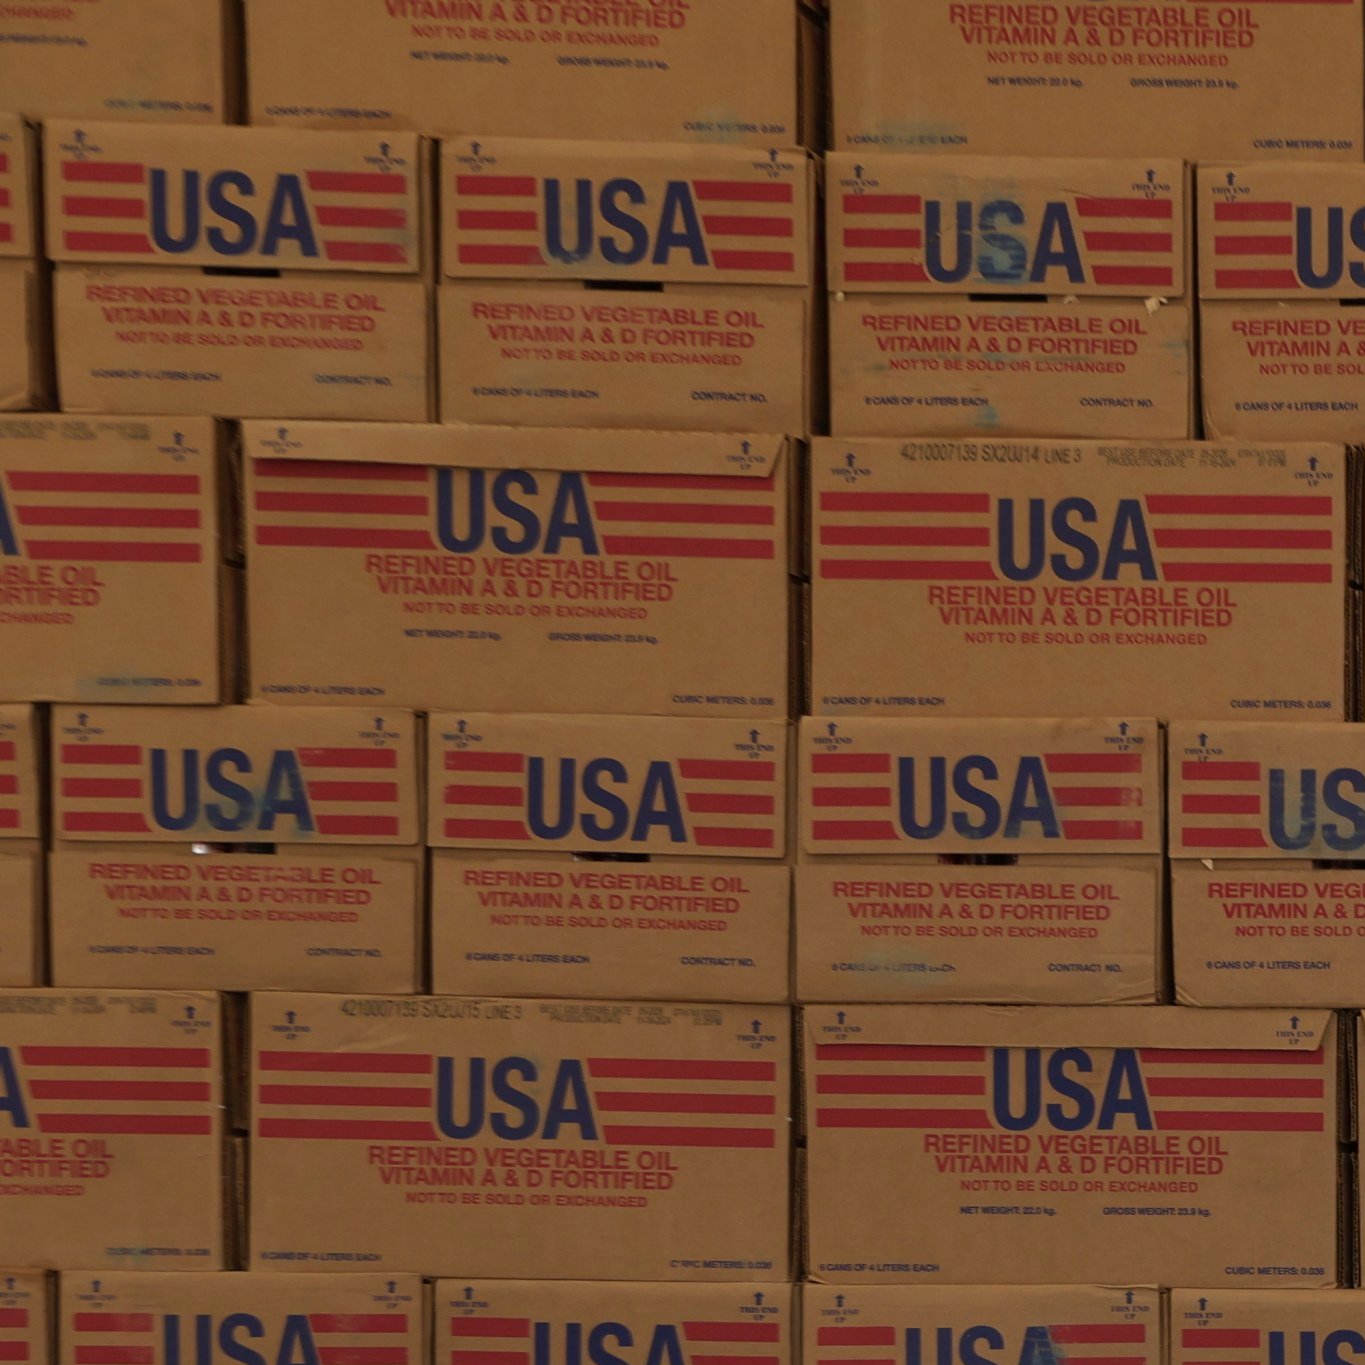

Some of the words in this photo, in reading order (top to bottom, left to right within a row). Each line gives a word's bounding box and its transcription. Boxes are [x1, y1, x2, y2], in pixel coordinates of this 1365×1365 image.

[153, 172, 316, 255] USA
[439, 471, 597, 553] USA
[530, 759, 684, 841] USA
[994, 1048, 1152, 1130] USA
[367, 1145, 477, 1166] REFINED
[484, 1147, 630, 1170] VEGETABLE
[637, 1150, 679, 1171] OIL
